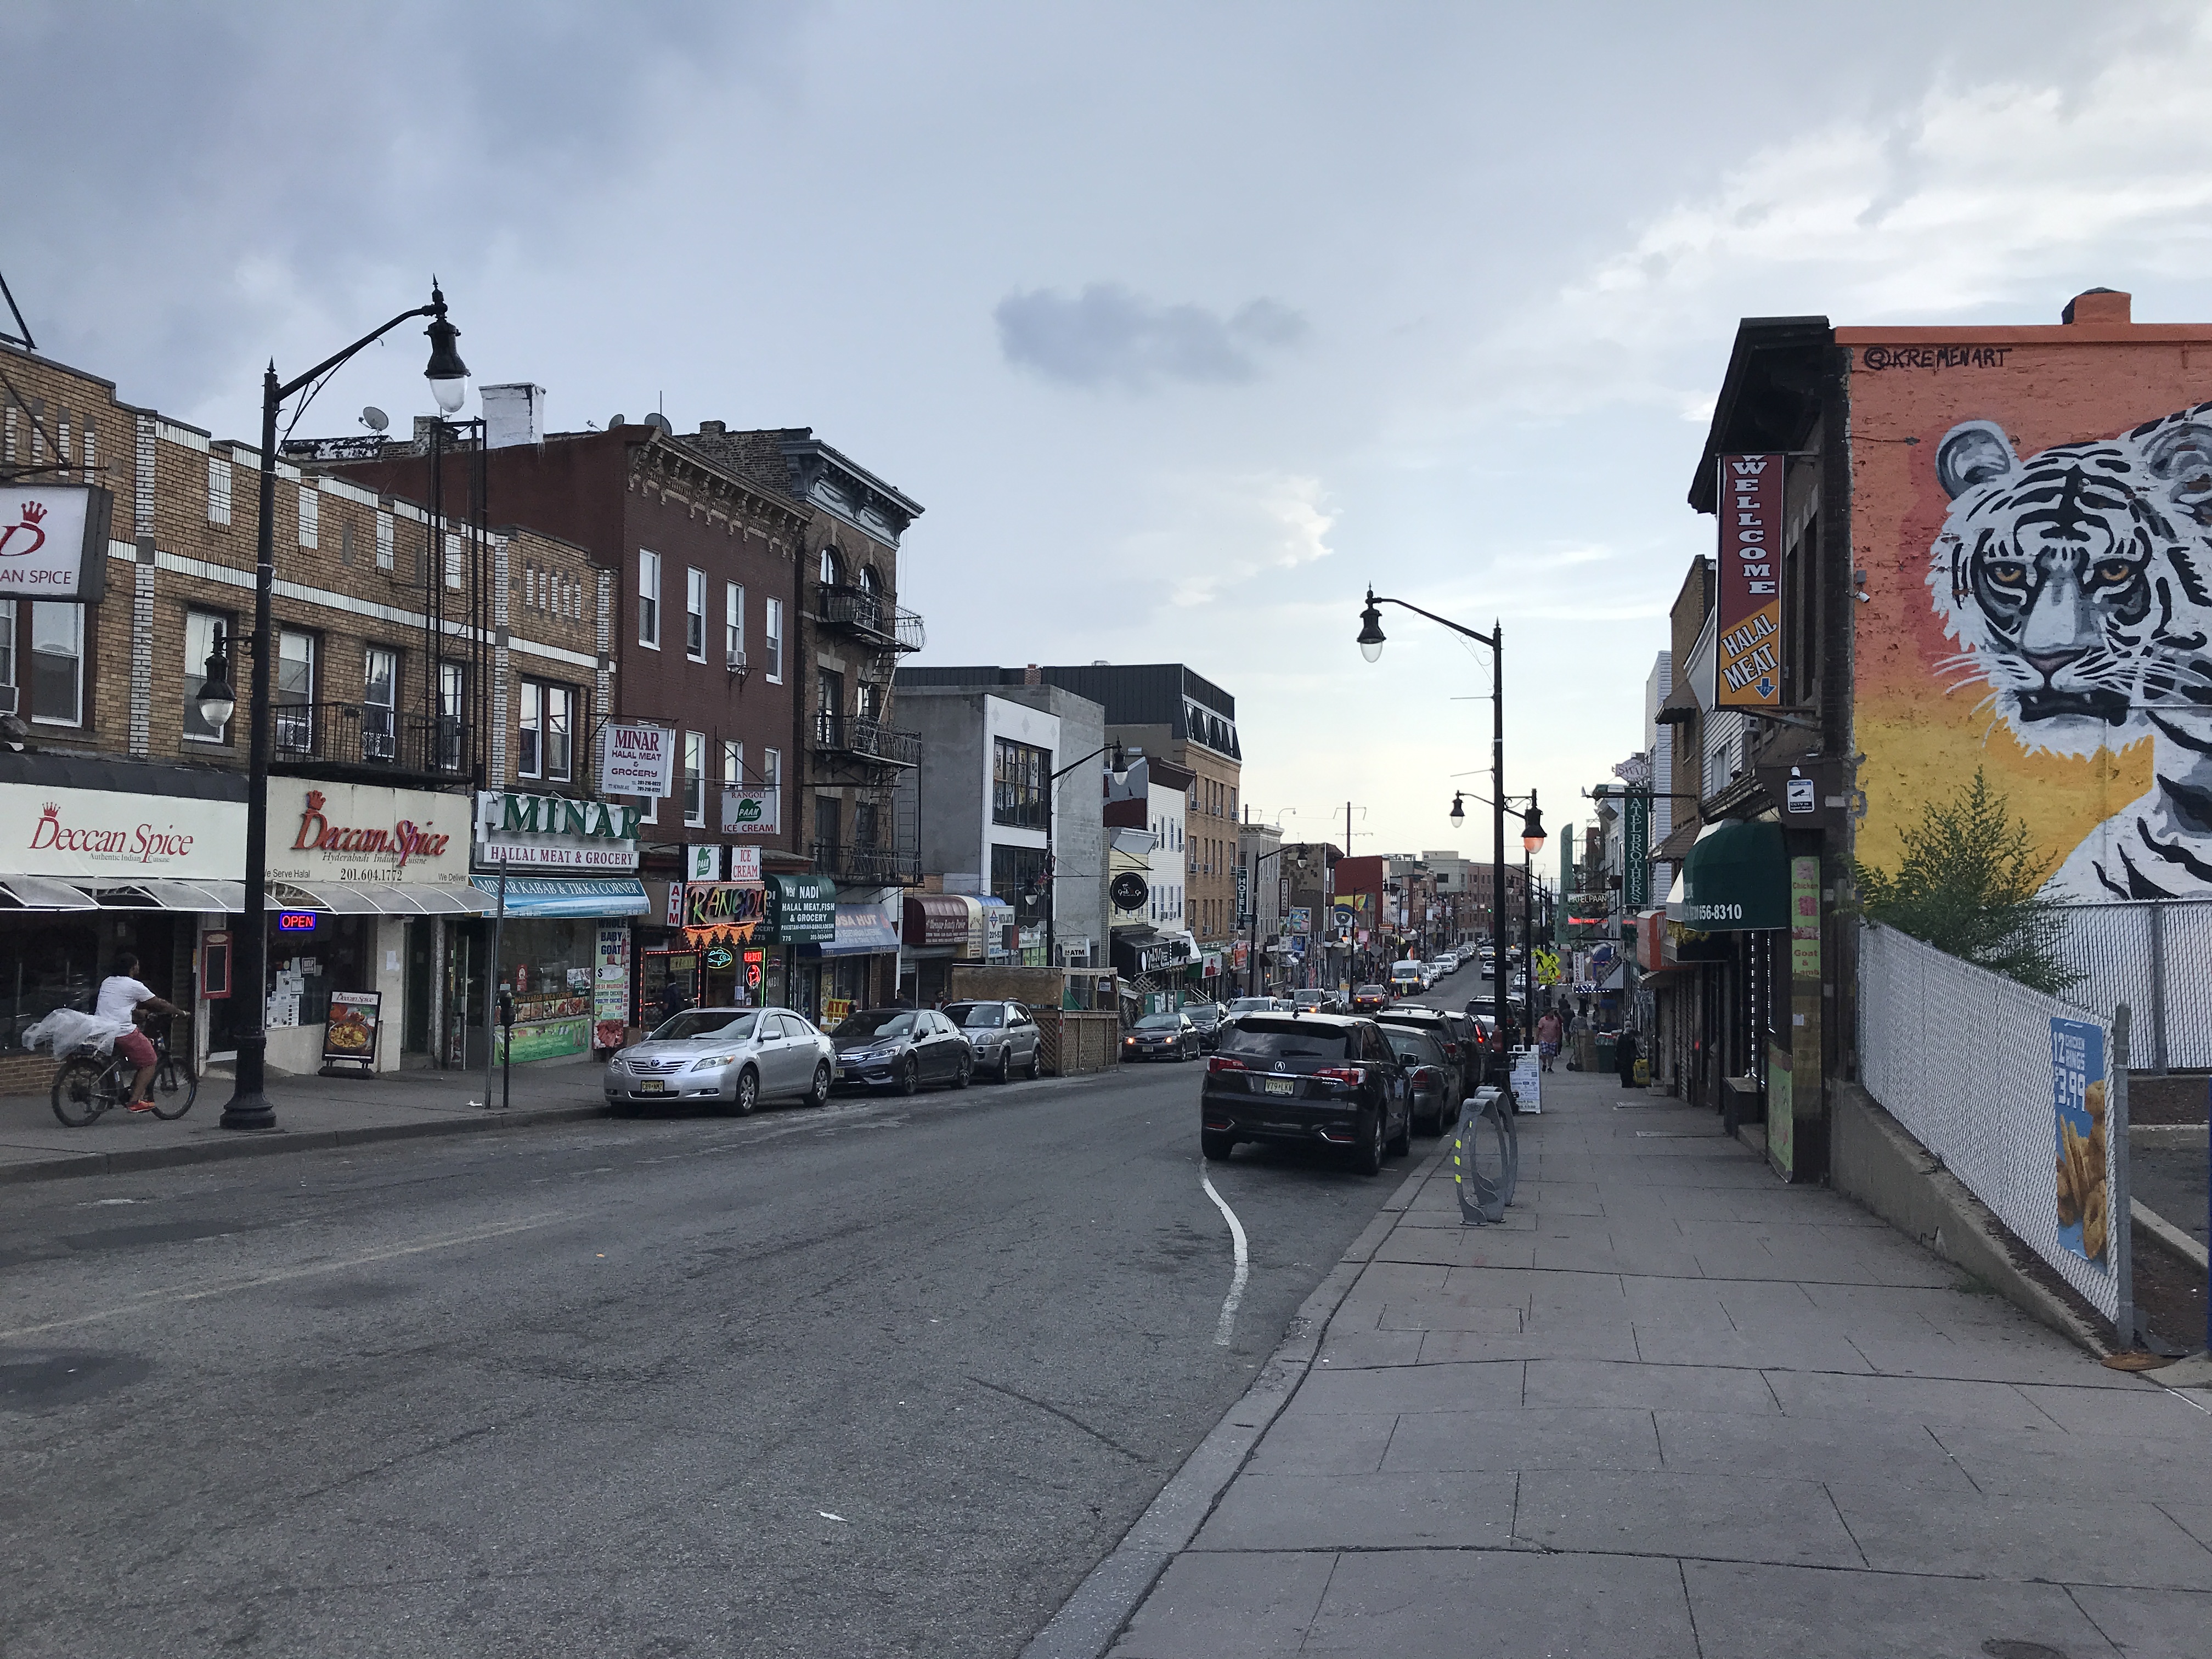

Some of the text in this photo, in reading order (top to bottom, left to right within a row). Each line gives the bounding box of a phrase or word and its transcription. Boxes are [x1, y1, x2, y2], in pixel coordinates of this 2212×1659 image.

[1864, 346, 2012, 370] @KREMENART
[1732, 461, 1776, 594] WELLCOME
[29, 570, 72, 585] SPICE
[1722, 613, 1777, 658] HALAL
[1723, 642, 1778, 693] MEAT
[614, 729, 659, 751] MINAR
[612, 750, 662, 761] HALAL MEAT
[611, 768, 658, 777] GROCERY
[501, 793, 642, 840] MINAR
[738, 808, 759, 816] PAAN
[742, 824, 774, 832] CREAM
[27, 816, 194, 864] Deccan Spice
[291, 811, 450, 867] Deccan Spice
[88, 853, 120, 861] Authentic
[121, 854, 141, 862] Indian
[323, 853, 427, 865] Hyderabadi Indian uisine
[490, 846, 633, 865] HALLAL MEAT & GROCERY
[741, 850, 752, 862] ICE
[698, 859, 709, 869] PAAN
[1630, 834, 1642, 904] BROTHERS
[273, 869, 292, 878] Serve
[294, 870, 311, 878] Halal
[341, 868, 402, 881] 201.604.1772
[733, 865, 758, 878] CREAM
[518, 882, 557, 895] KABAB
[557, 883, 565, 894] &
[565, 882, 599, 895] TIKKA
[599, 882, 639, 894] CORNER
[799, 885, 819, 899] NADI
[1237, 878, 1246, 912] HOTEL
[669, 885, 680, 924] ATM
[690, 885, 768, 924] RANGOLI
[782, 903, 802, 912] HALAL
[282, 915, 314, 928] OPEN
[597, 918, 627, 928] WHOLE
[797, 914, 827, 922] GROCERY
[856, 915, 877, 926] HUT
[601, 932, 622, 941] BABY
[601, 945, 621, 955] GOAT
[597, 968, 602, 978] $
[2053, 1031, 2065, 1064] 12
[2055, 1065, 2085, 1113] $3.99
